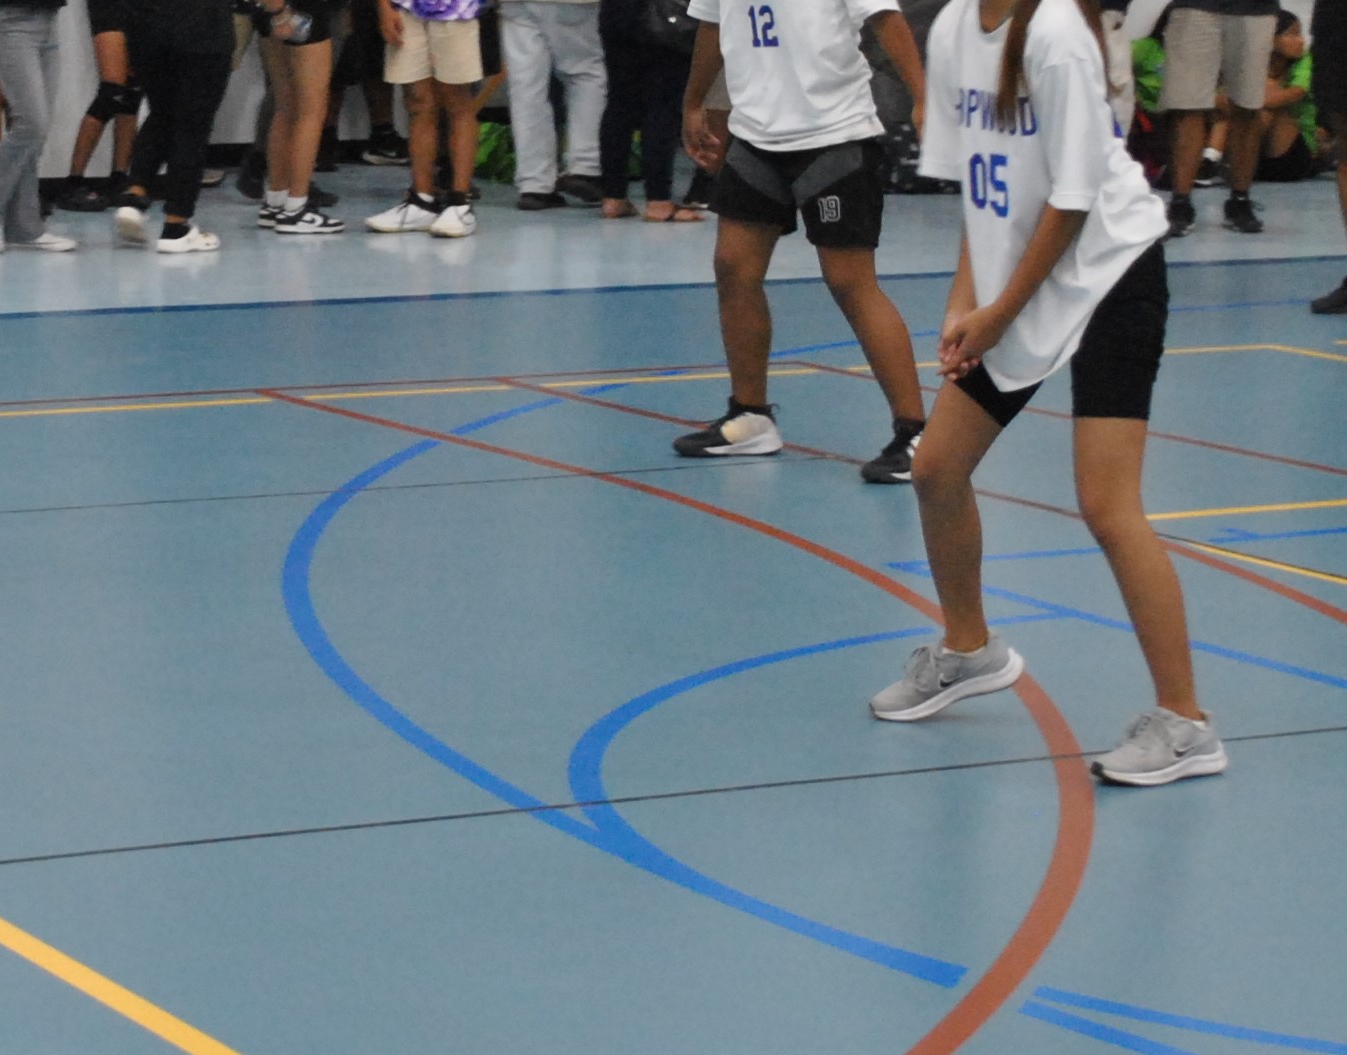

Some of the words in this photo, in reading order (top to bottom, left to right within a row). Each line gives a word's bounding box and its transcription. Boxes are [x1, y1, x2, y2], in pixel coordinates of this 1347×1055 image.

[748, 5, 779, 48] 12
[969, 153, 1009, 219] 05
[817, 195, 842, 223] 19
